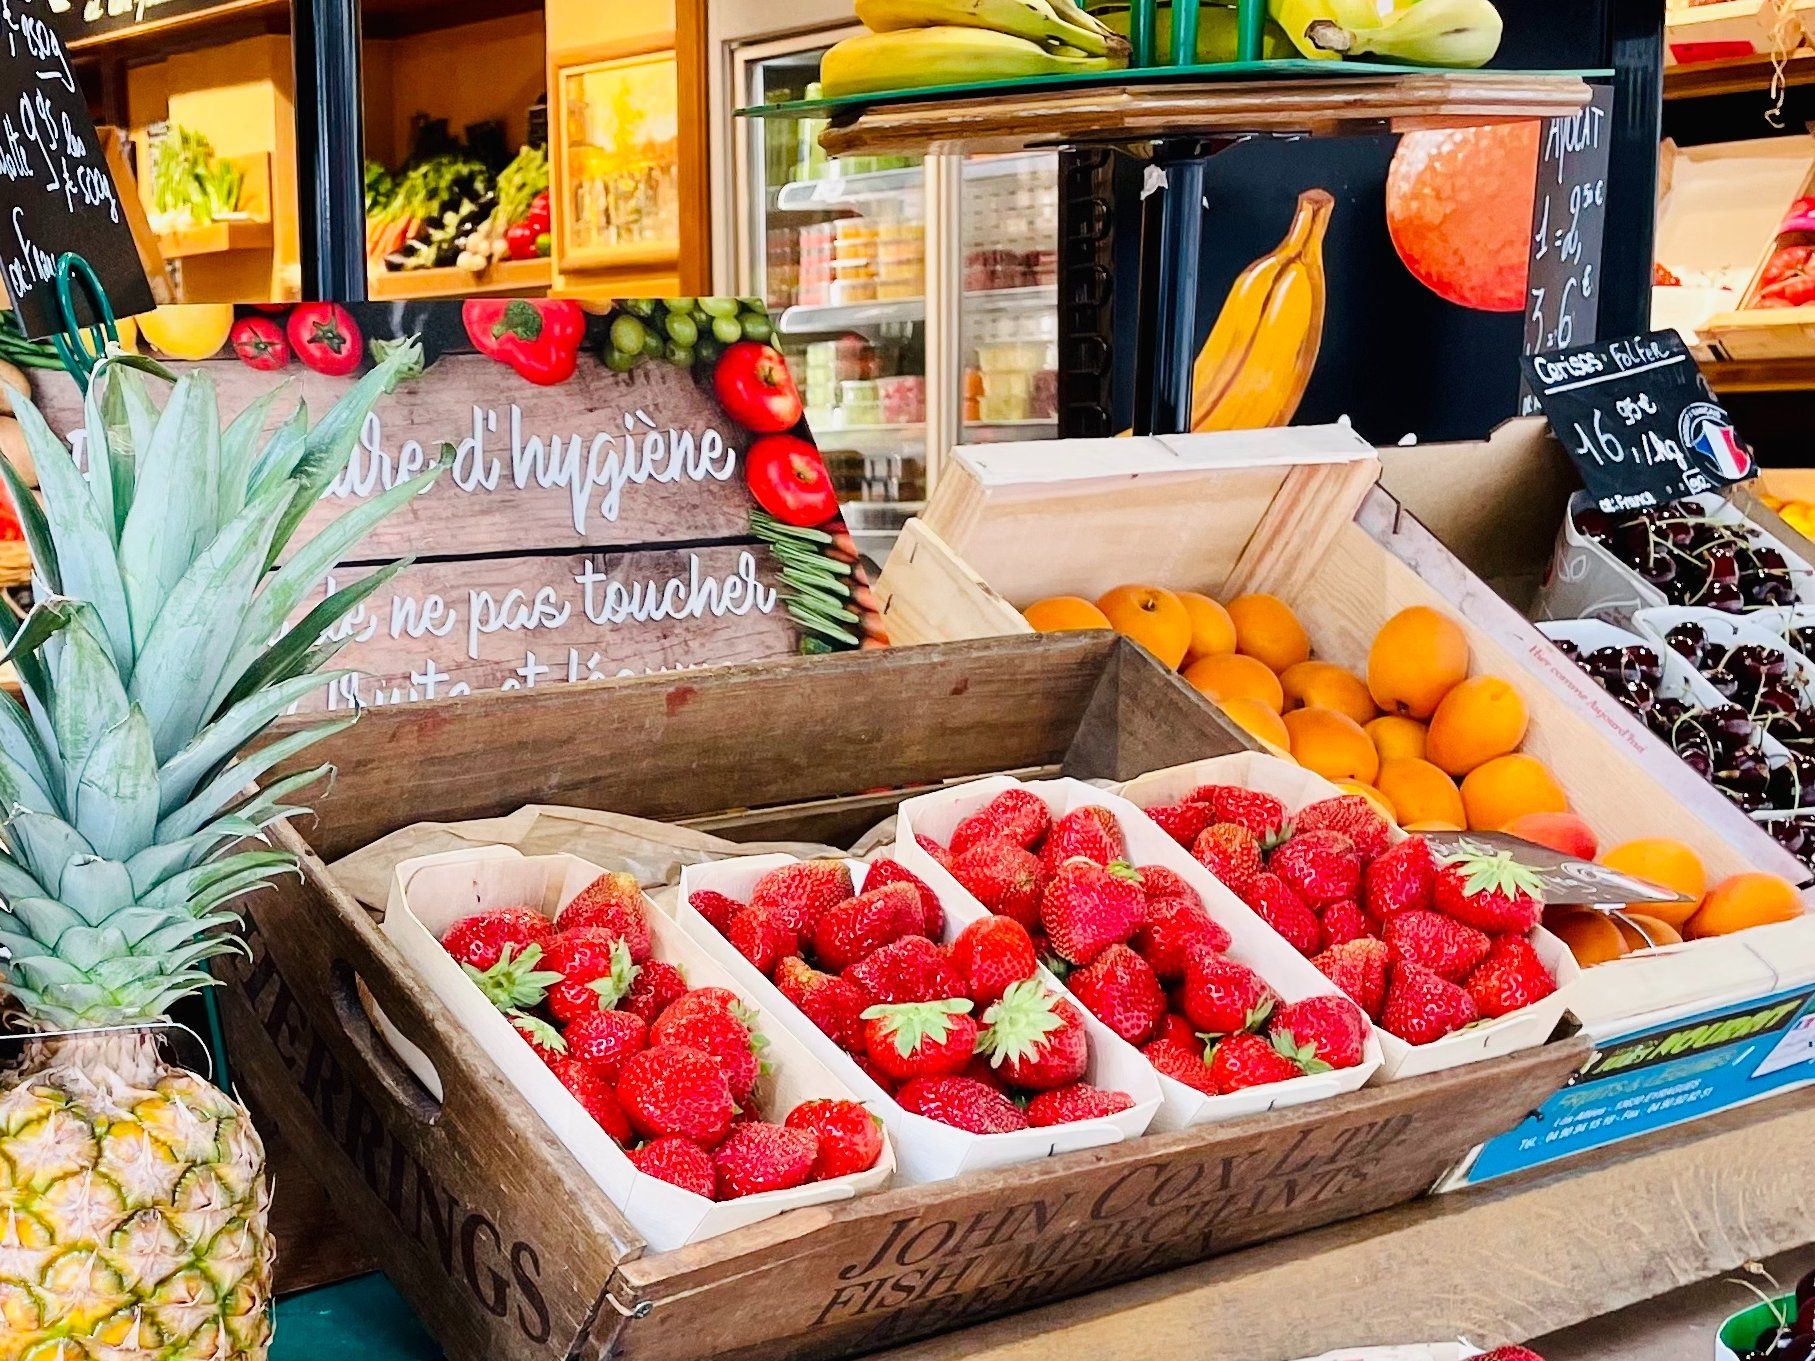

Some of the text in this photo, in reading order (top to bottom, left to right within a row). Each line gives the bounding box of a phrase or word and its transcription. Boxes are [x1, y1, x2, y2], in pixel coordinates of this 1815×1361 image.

[390, 594, 457, 640] ne
[468, 586, 572, 660] pas
[574, 550, 778, 626] toucher
[813, 1158, 1386, 1328] FISH MERCHANTS
